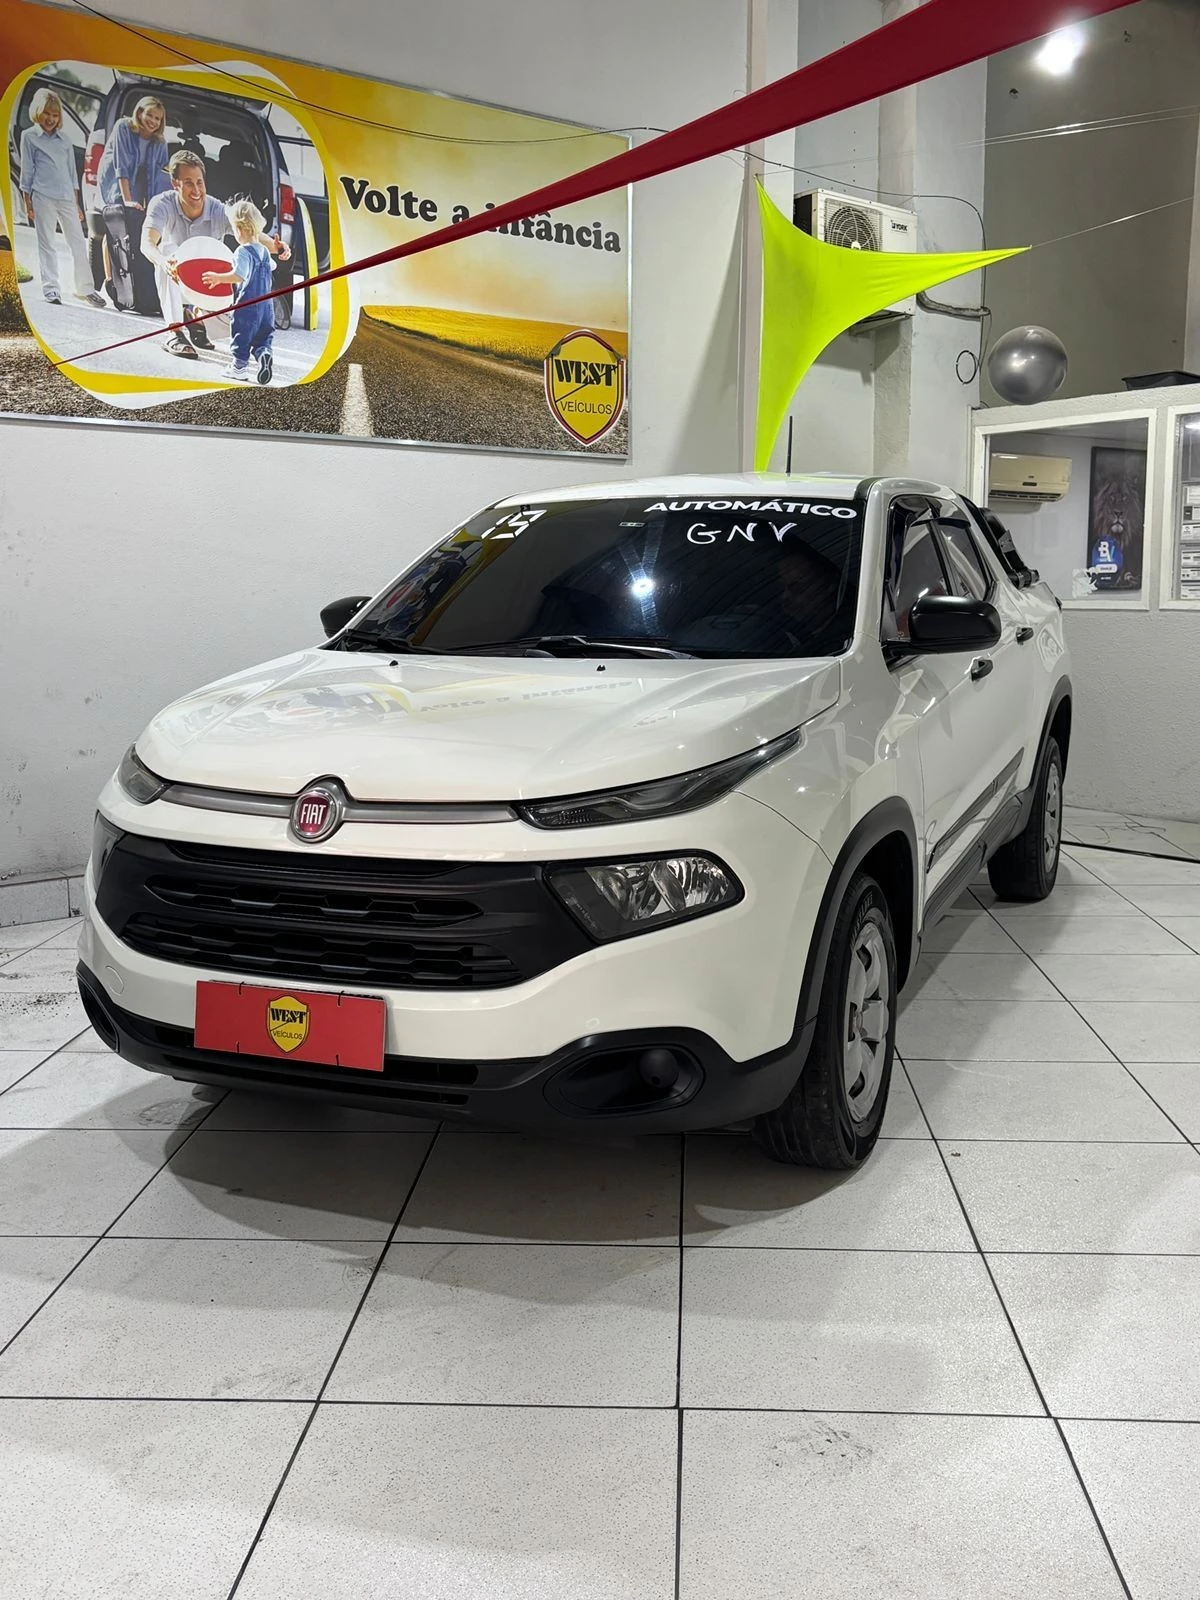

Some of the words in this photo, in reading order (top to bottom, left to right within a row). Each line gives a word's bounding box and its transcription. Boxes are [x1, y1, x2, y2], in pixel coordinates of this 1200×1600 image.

[340, 177, 438, 221] Volte
[452, 205, 470, 224] a
[554, 359, 618, 387] WEST
[560, 400, 613, 415] VEÍCULOS
[644, 499, 858, 519] AUTOMÁTICO
[300, 803, 327, 825] FIAT
[270, 1007, 307, 1025] WEST
[273, 1030, 303, 1040] VEÍCULOS
